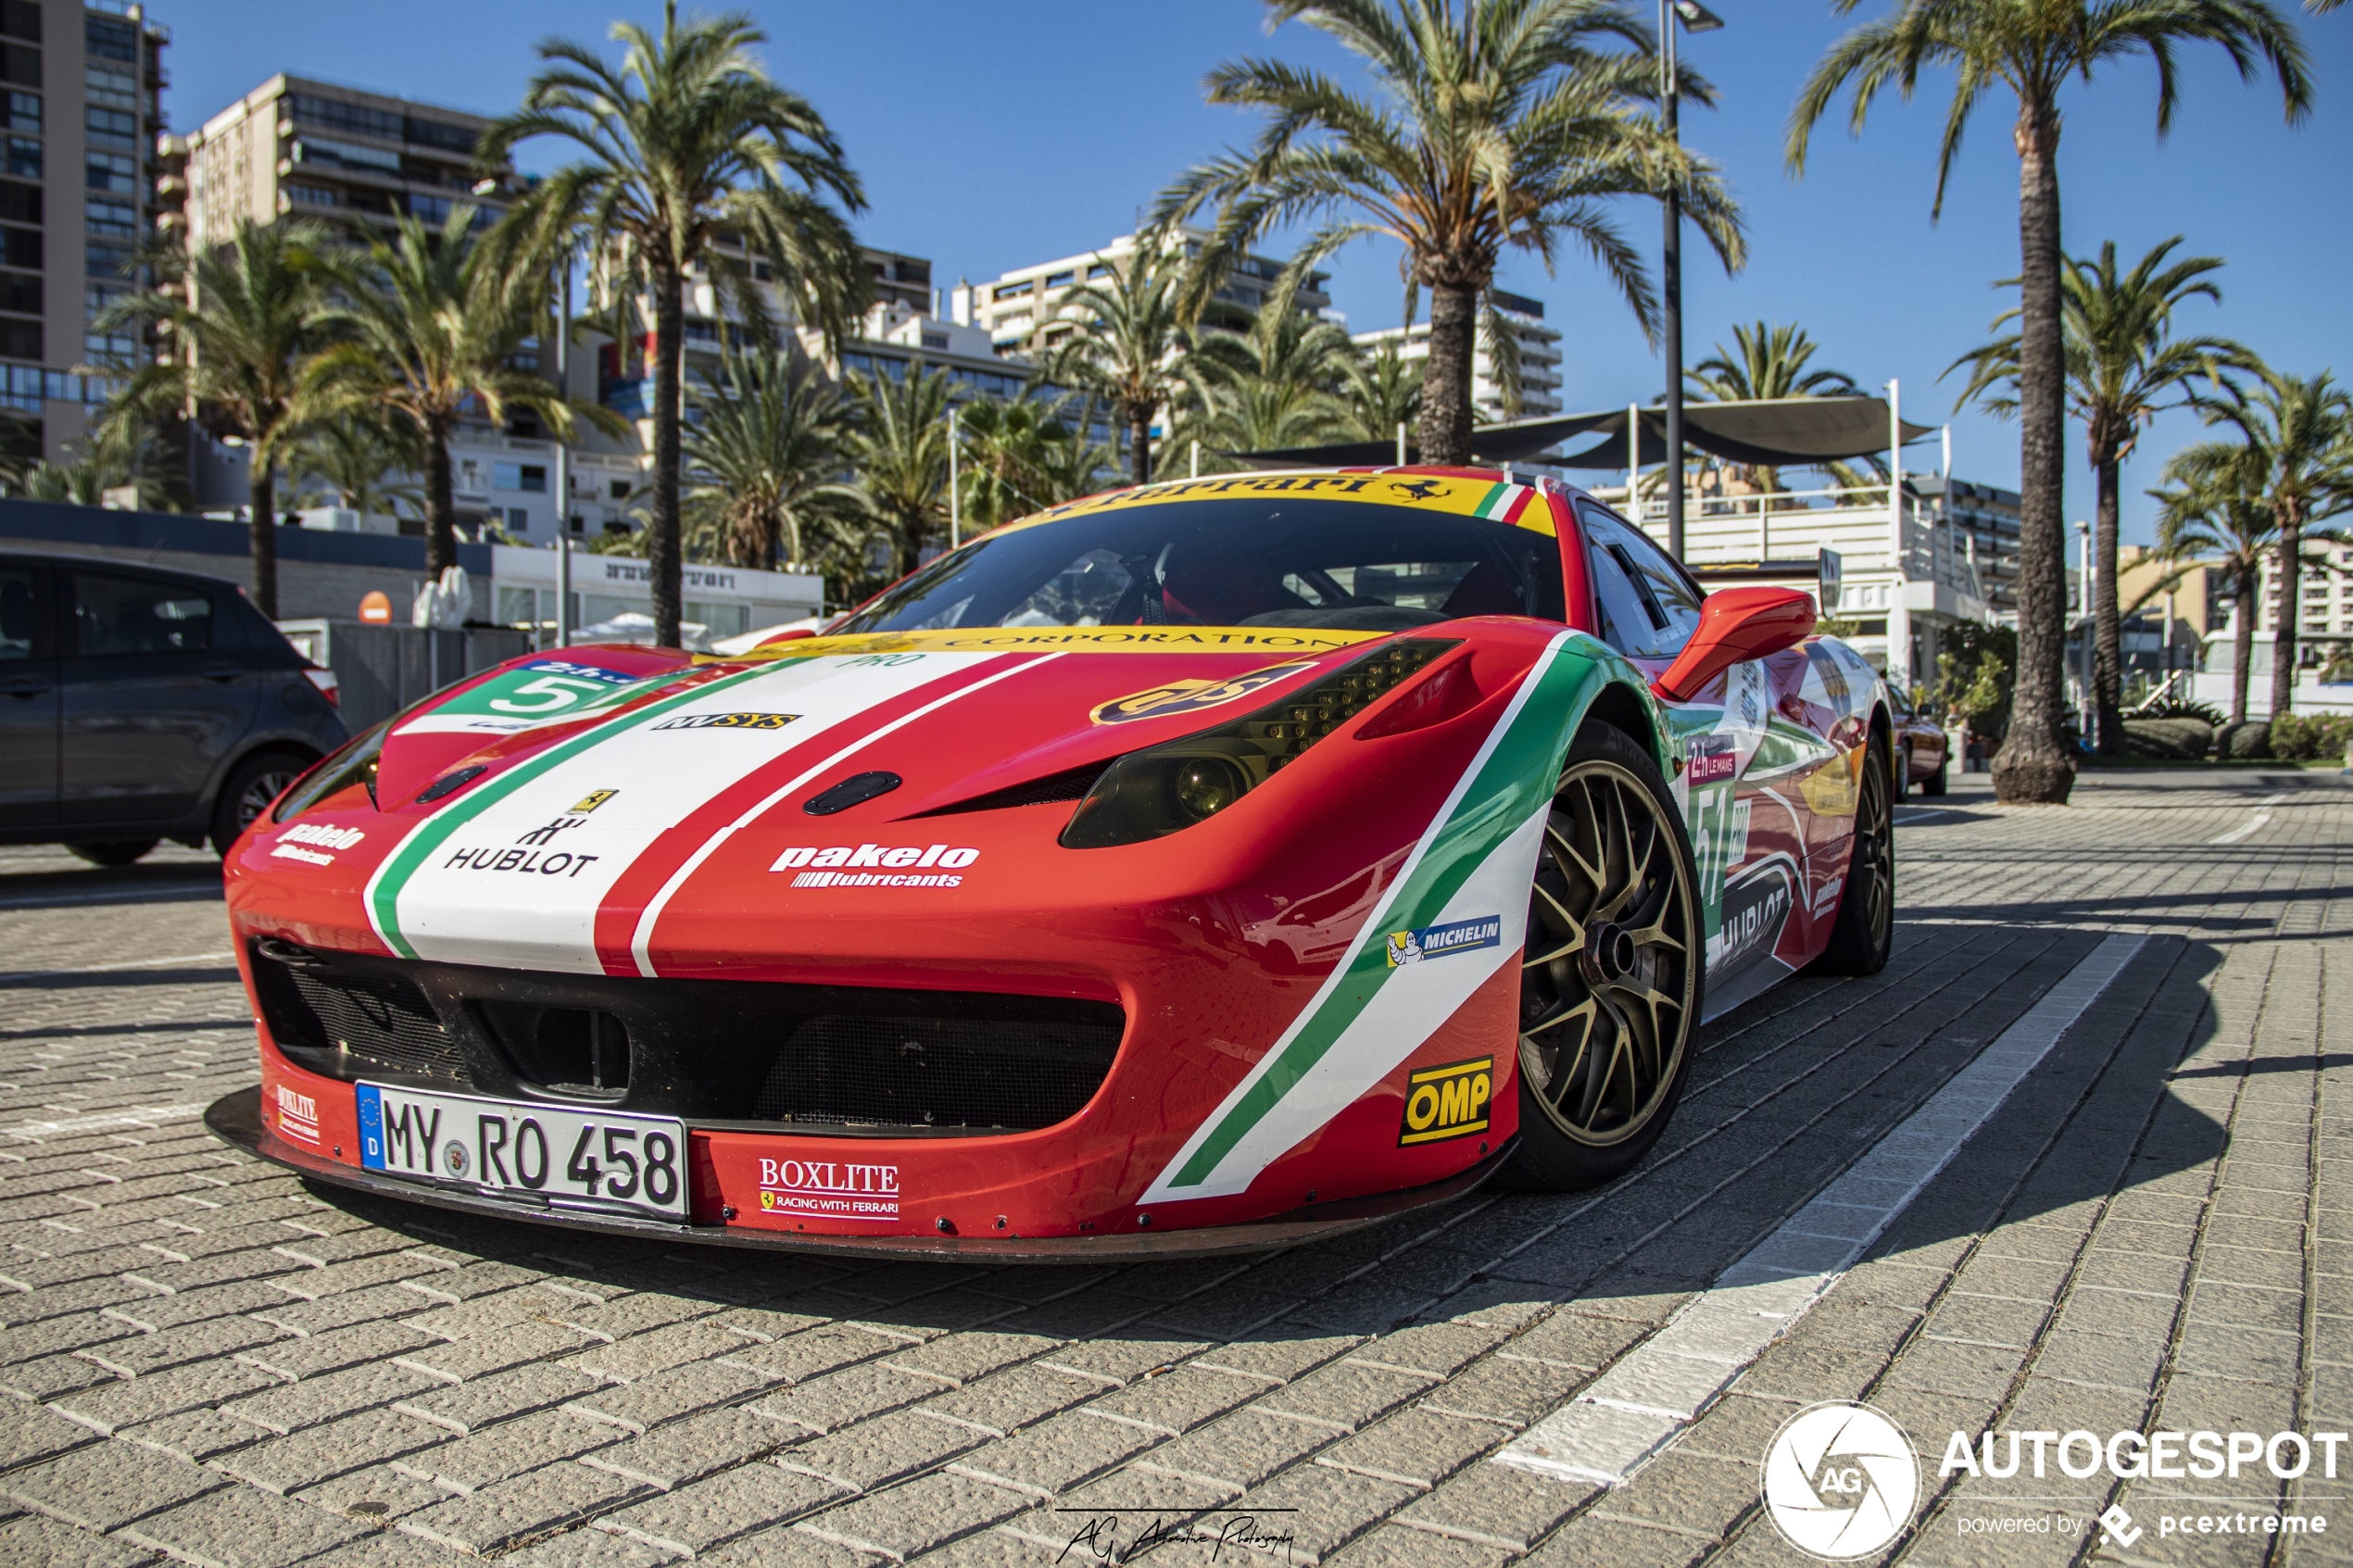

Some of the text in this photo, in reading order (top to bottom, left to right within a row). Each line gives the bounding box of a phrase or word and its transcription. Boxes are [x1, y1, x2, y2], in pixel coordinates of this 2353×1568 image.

[945, 632, 1349, 647] CORPORATION
[834, 654, 927, 668] PRO
[1718, 758, 1732, 773] MANS
[276, 823, 366, 851] pakelo
[1694, 786, 1727, 905] 51
[444, 848, 599, 878] HUBLOT
[768, 844, 980, 872] pakelo
[829, 872, 963, 887] lubricants
[1424, 922, 1498, 949] MICHELIN
[1407, 1073, 1490, 1130] OMP
[368, 1137, 378, 1156] D
[384, 1099, 442, 1173] MY
[478, 1114, 550, 1190] RO
[567, 1123, 680, 1205] 458
[759, 1159, 900, 1193] BOXLITE
[776, 1196, 899, 1213] RACING WITH FERRARI
